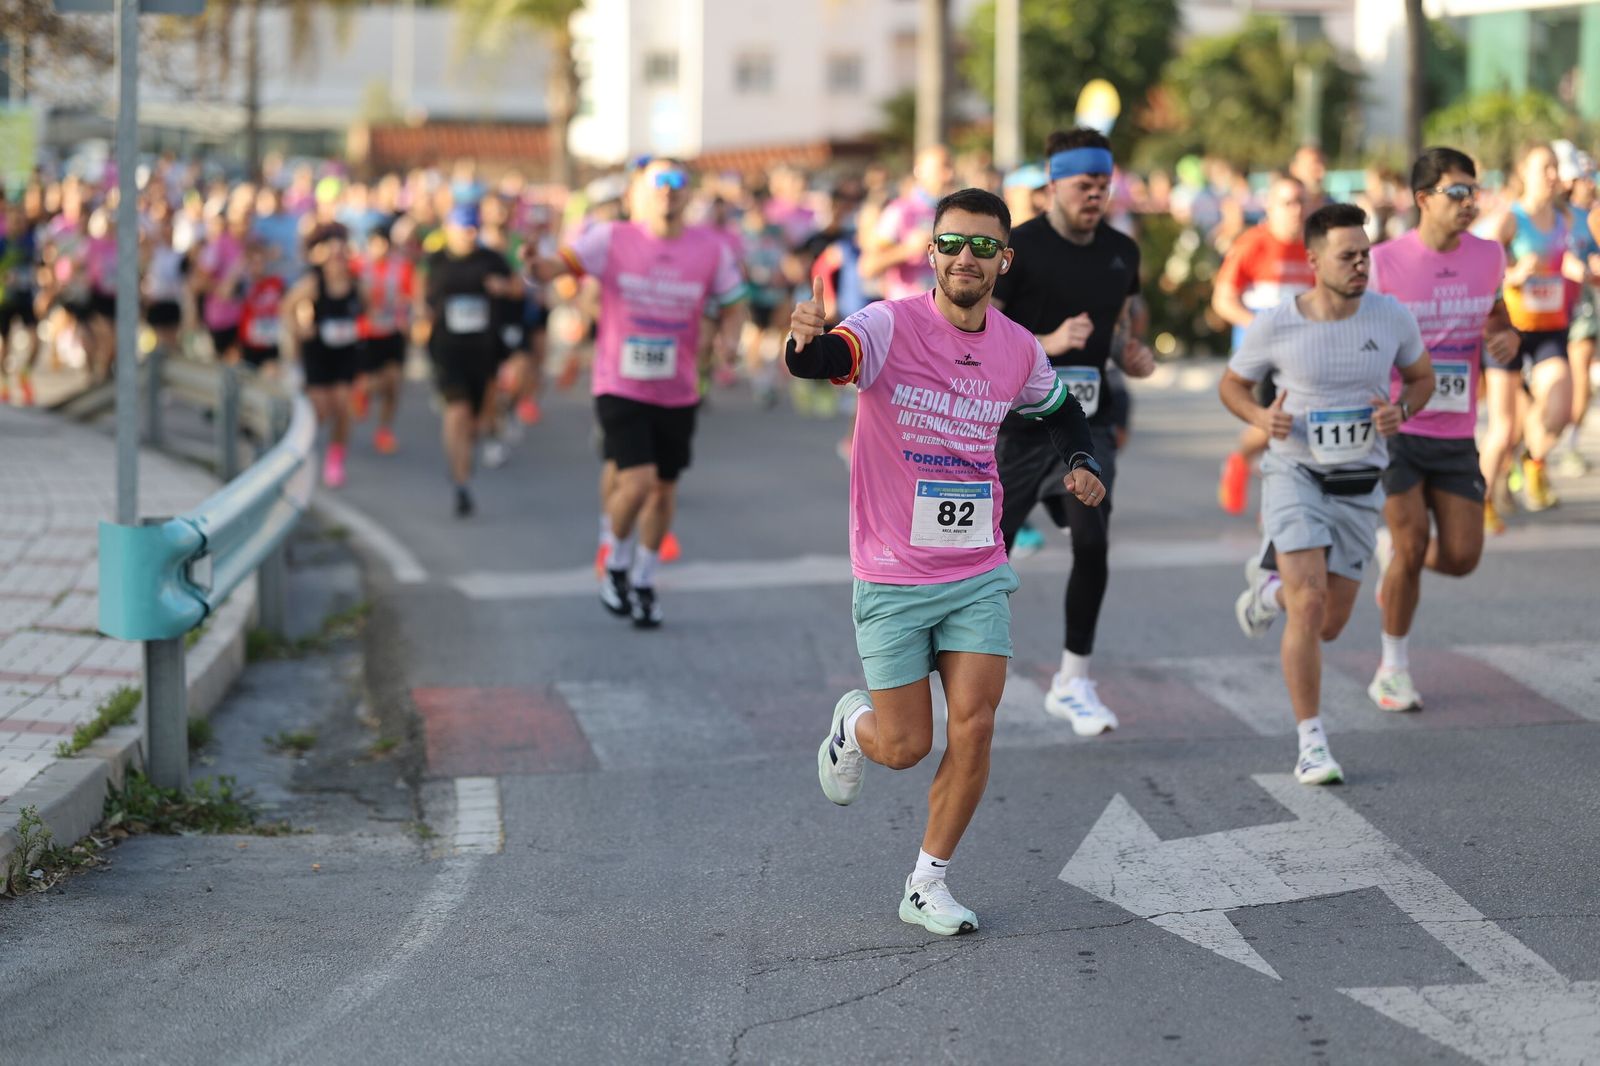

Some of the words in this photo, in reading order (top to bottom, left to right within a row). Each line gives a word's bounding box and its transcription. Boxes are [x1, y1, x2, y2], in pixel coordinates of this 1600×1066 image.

[949, 377, 991, 397] XXXVI
[1069, 383, 1095, 402] 20
[1435, 375, 1466, 396] 59
[890, 383, 951, 416] MEDIA
[1313, 422, 1372, 445] 1117
[937, 500, 975, 527] 82
